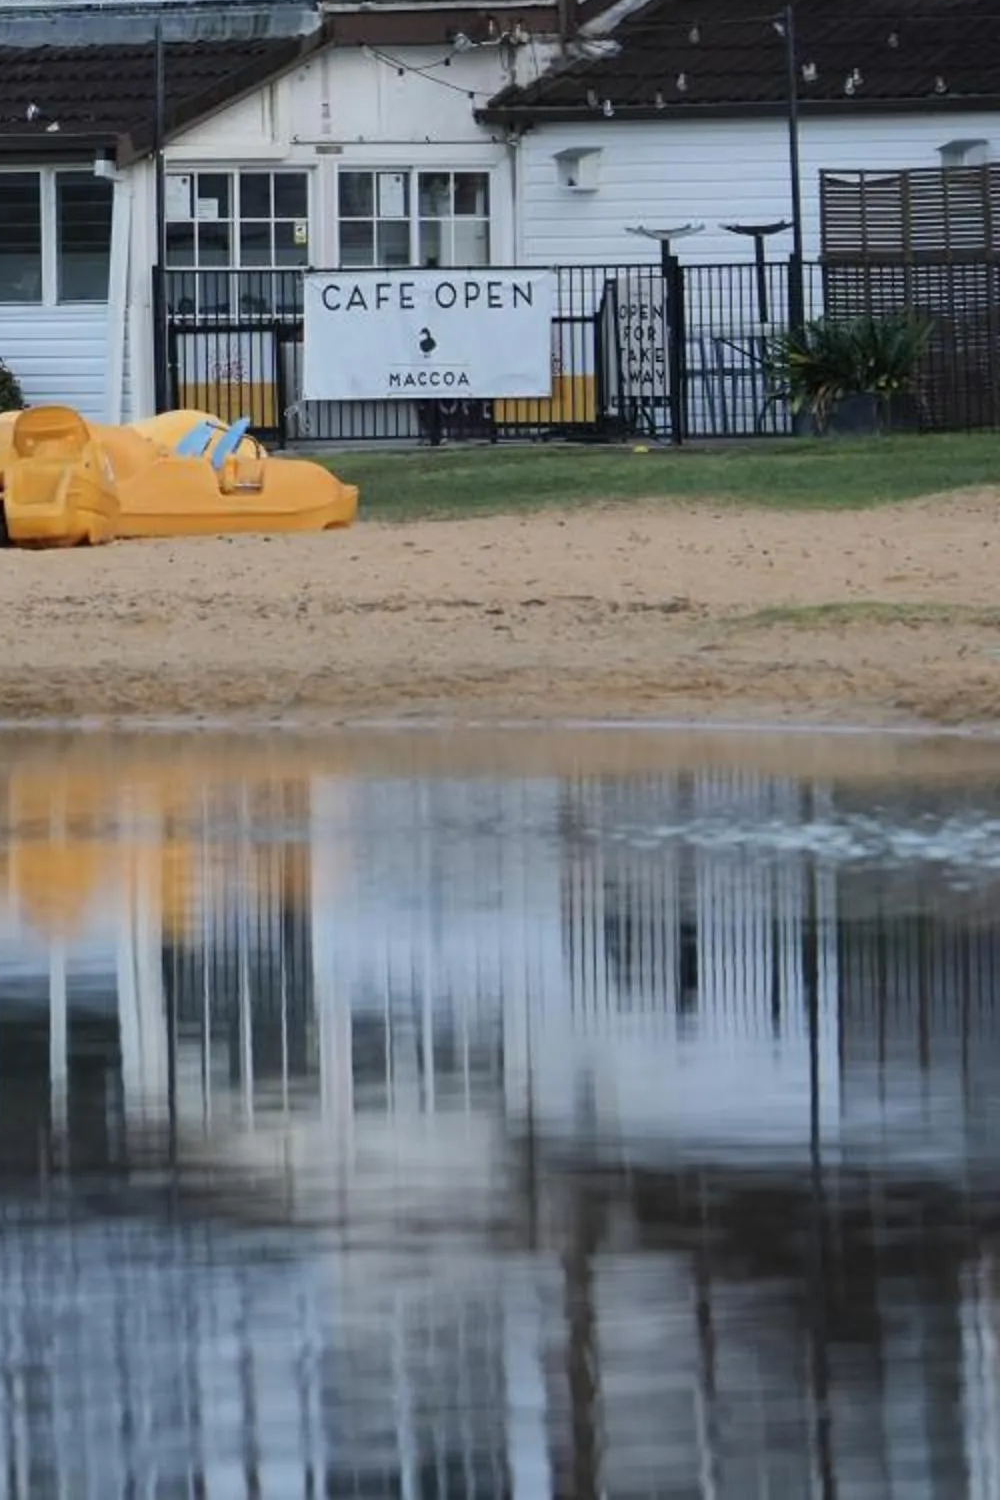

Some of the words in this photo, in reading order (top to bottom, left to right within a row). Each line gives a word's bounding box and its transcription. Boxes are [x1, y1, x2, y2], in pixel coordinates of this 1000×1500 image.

[321, 282, 416, 311] CAFE
[435, 281, 534, 309] OPEN
[619, 304, 663, 320] OPEN
[624, 325, 656, 341] FOR
[388, 371, 470, 388] MACCOA
